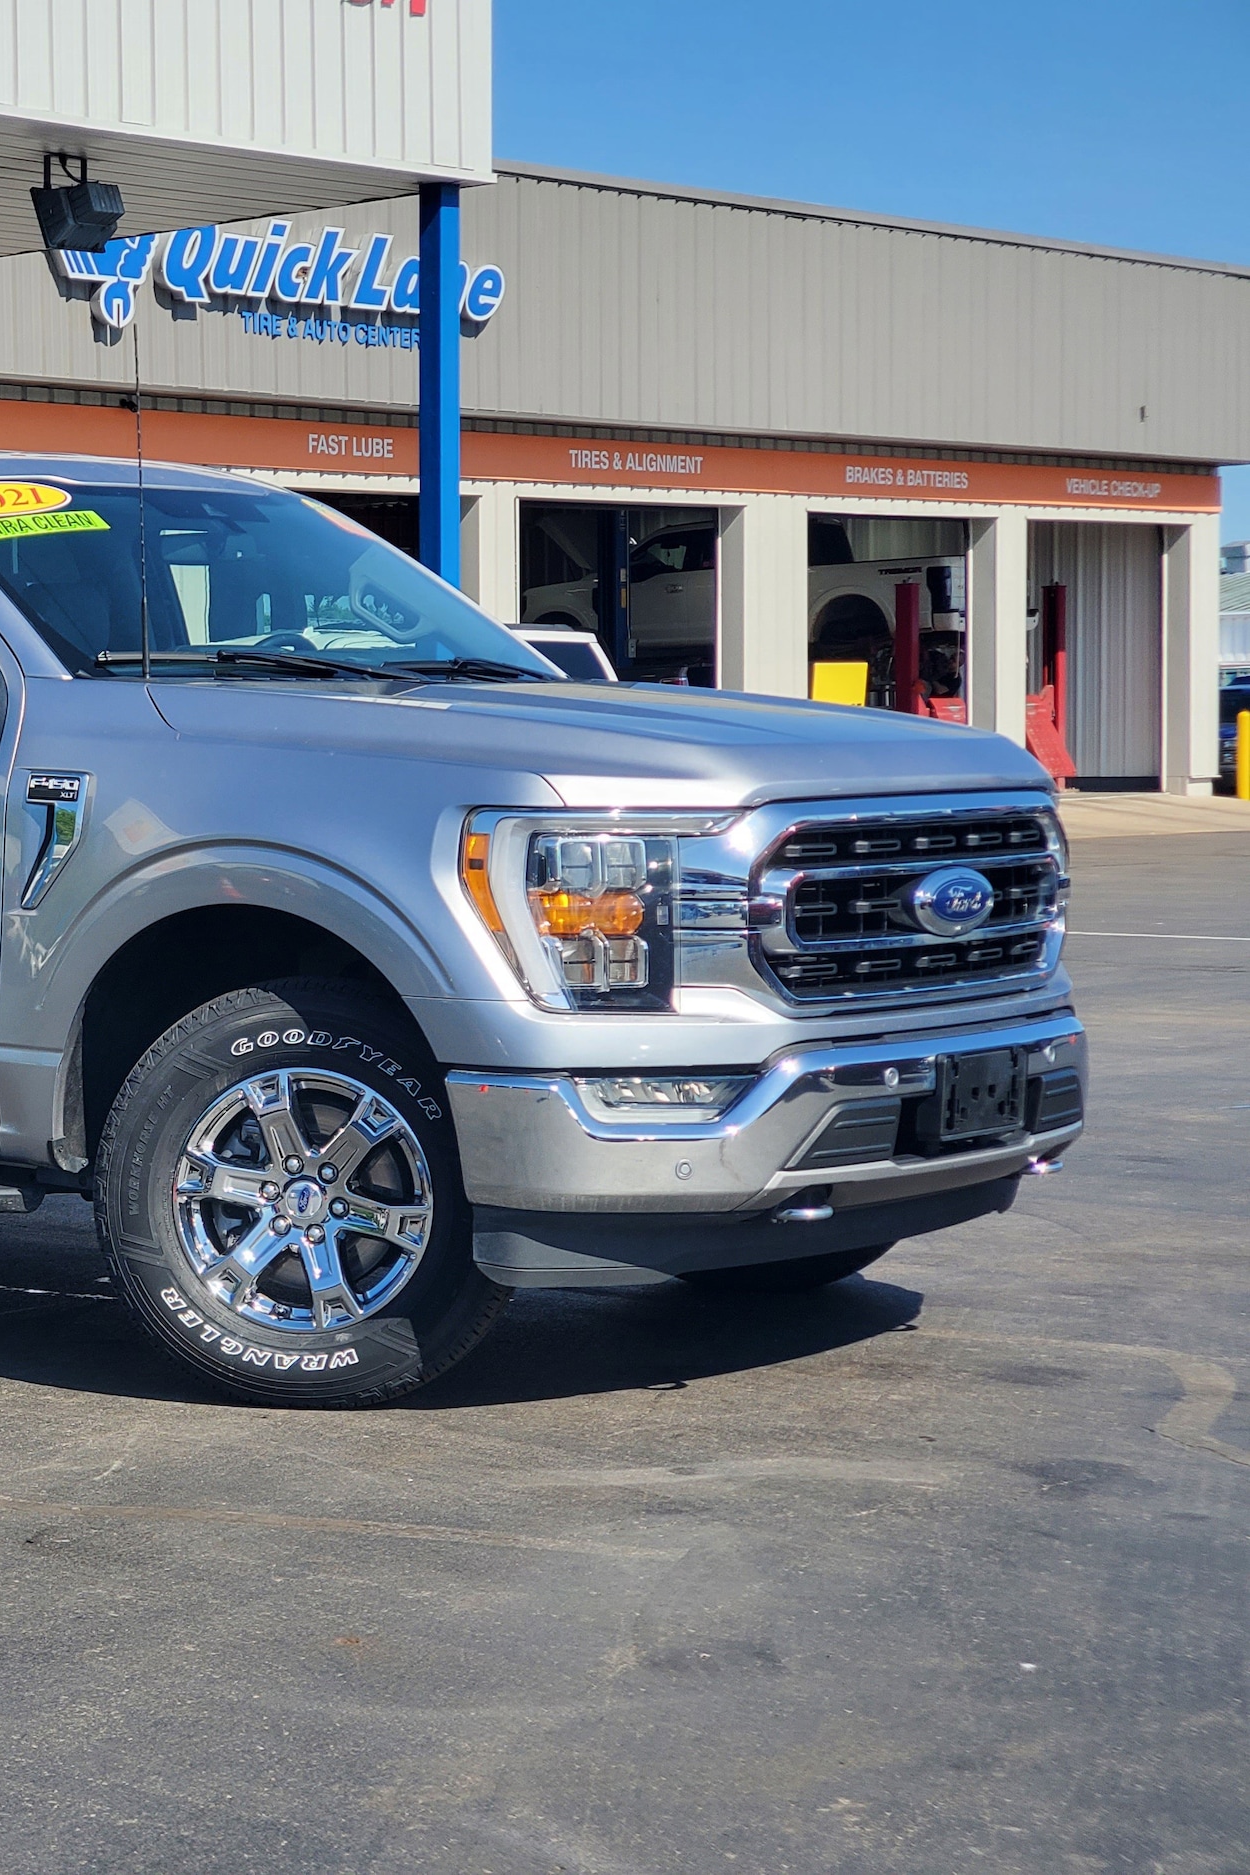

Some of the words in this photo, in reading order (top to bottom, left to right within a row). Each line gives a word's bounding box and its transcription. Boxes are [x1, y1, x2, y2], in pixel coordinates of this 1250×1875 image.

[163, 219, 358, 306] Quick
[241, 311, 283, 336] TIRE
[287, 317, 299, 338] &
[303, 319, 351, 343] AUTO
[308, 433, 348, 456] FAST
[352, 436, 393, 459] LUBE
[569, 448, 609, 471] TIRES
[613, 452, 623, 471] &
[625, 452, 704, 475] ALIGNMENT
[845, 465, 893, 486] BRAKES
[896, 468, 905, 486] &
[907, 470, 969, 489] BATTERIES
[1066, 478, 1109, 497] VEHICLE
[1110, 480, 1161, 499] CHECK-UP
[32, 513, 94, 530] CLEAN
[30, 777, 80, 791] F-150
[231, 1029, 442, 1120] GOODYEAR
[160, 1287, 359, 1371] WRANGLER
